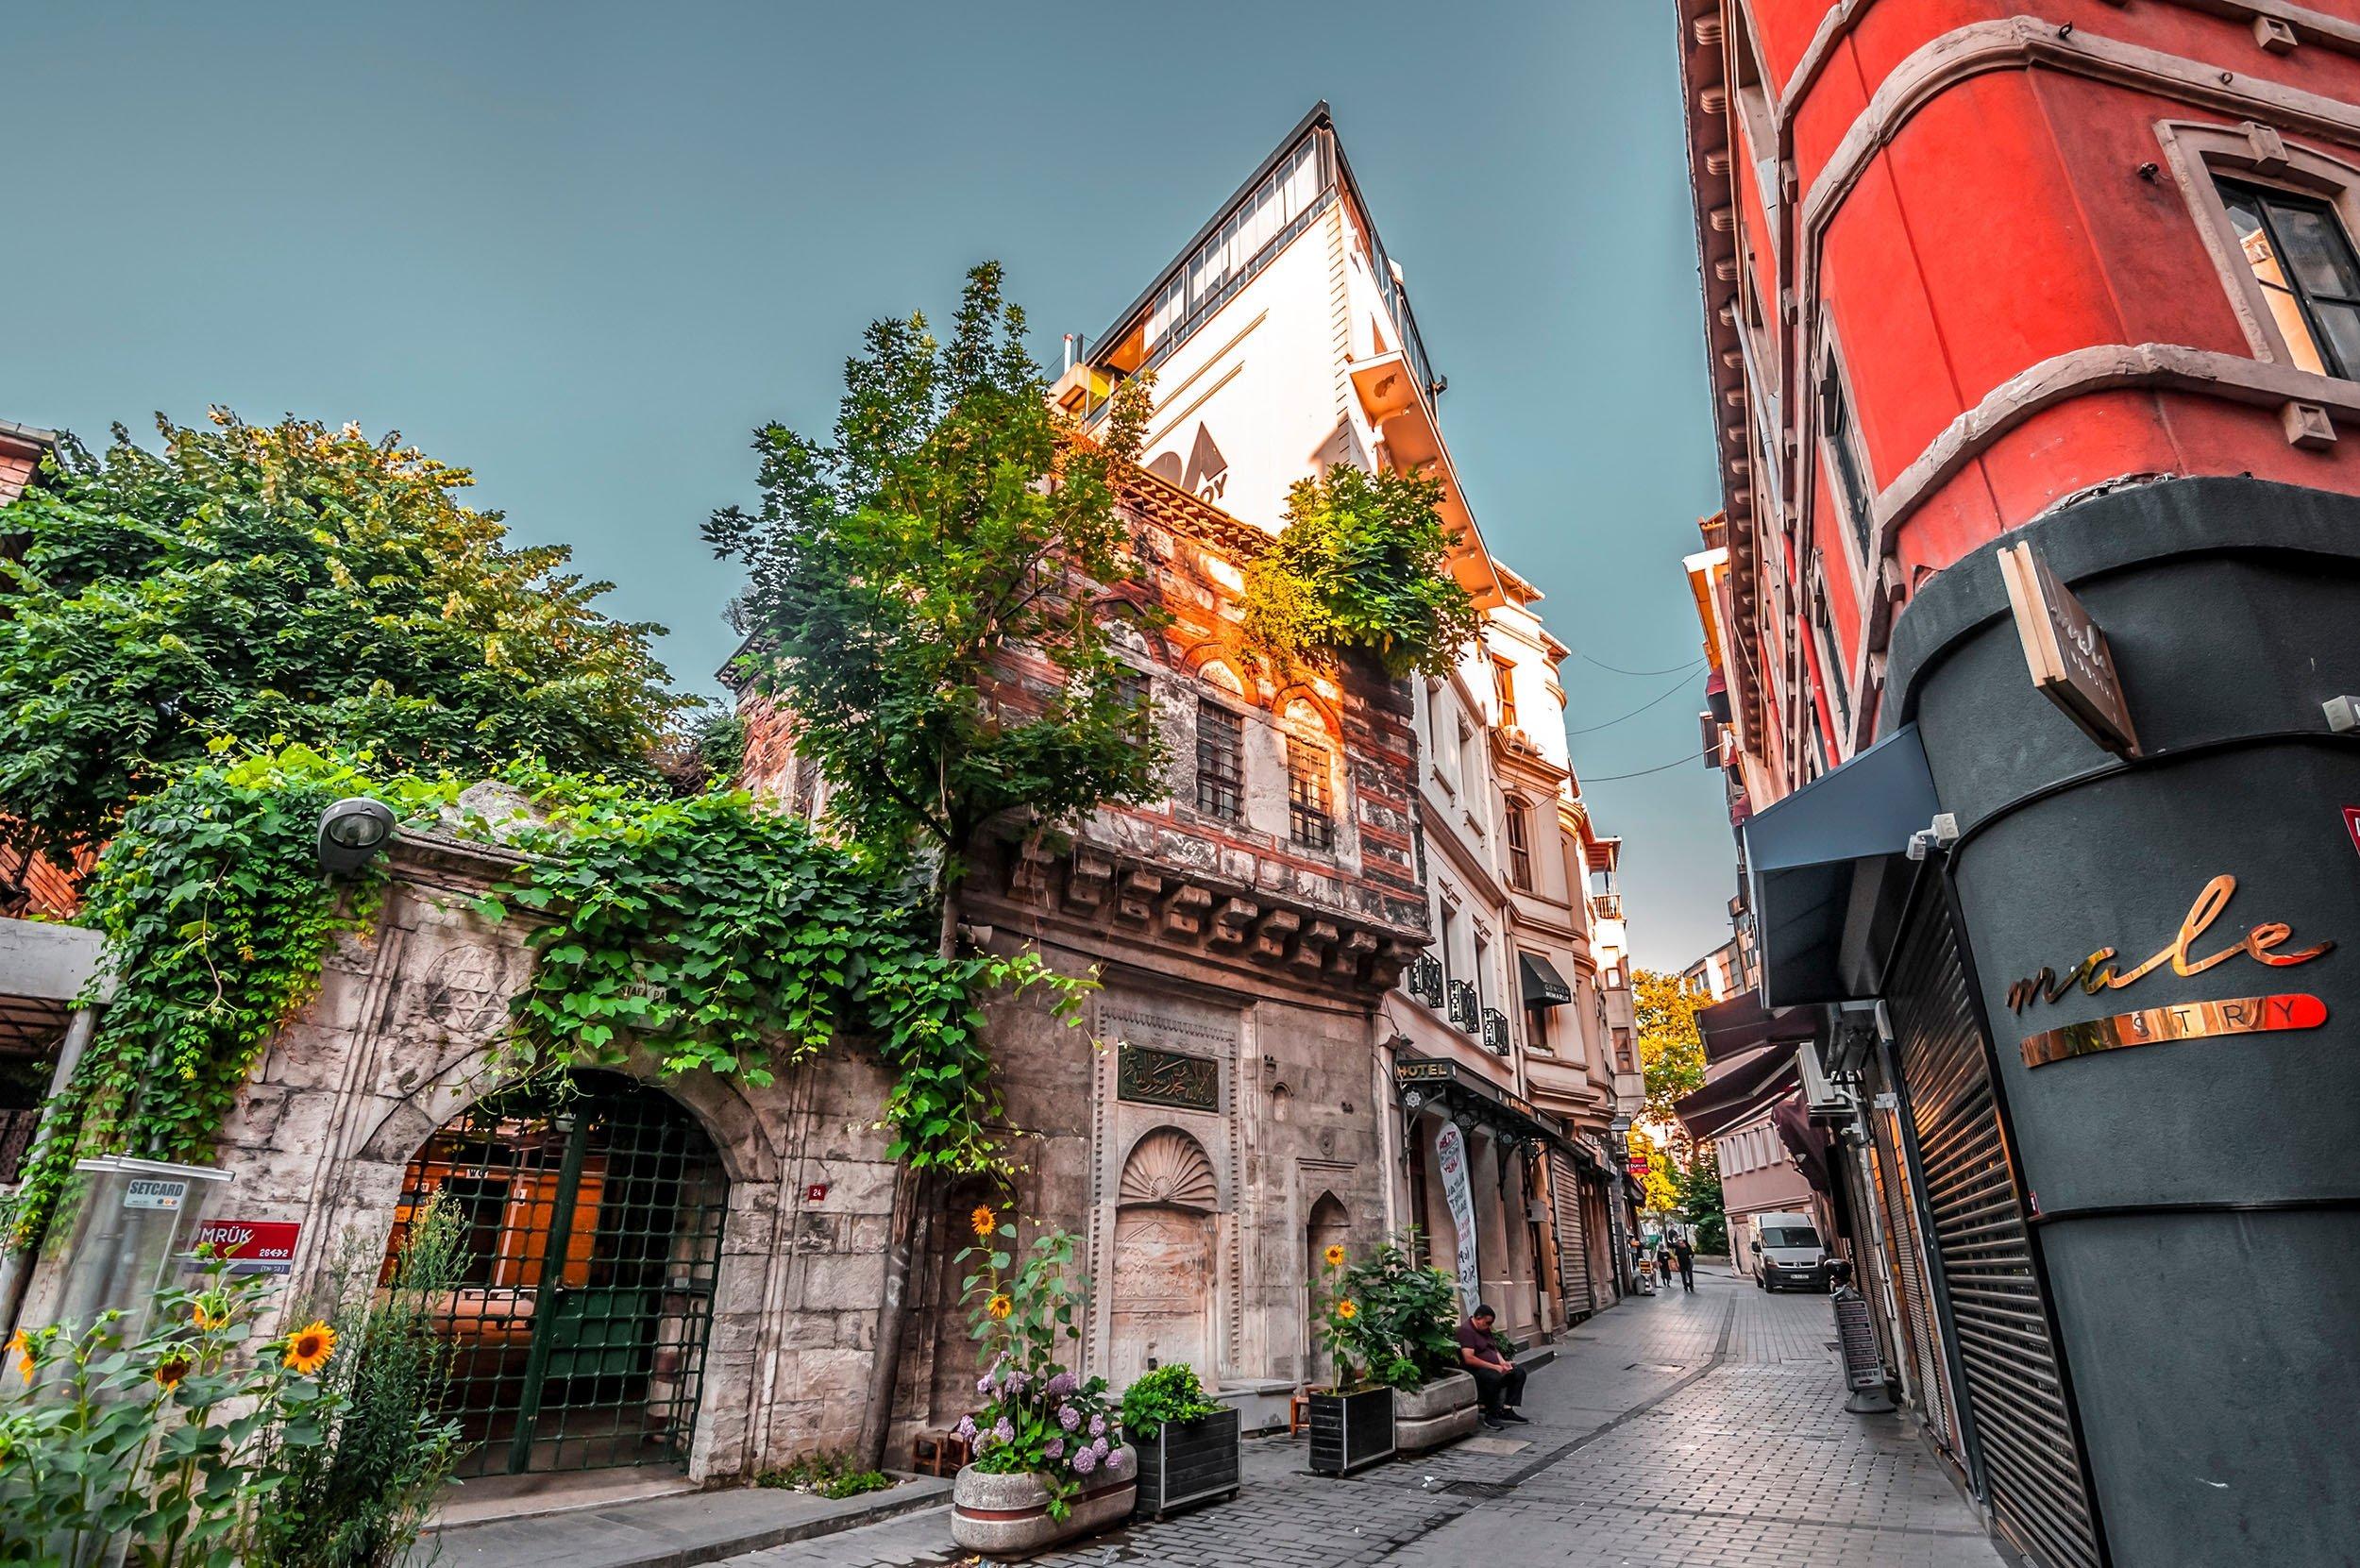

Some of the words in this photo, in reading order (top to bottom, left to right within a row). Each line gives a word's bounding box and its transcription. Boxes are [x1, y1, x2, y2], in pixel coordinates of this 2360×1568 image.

[2005, 874, 2335, 1015] male
[1397, 1064, 1447, 1077] HOTEL
[129, 1181, 184, 1197] SETCARD
[813, 1189, 821, 1197] 24
[190, 1225, 253, 1244] MRÜK
